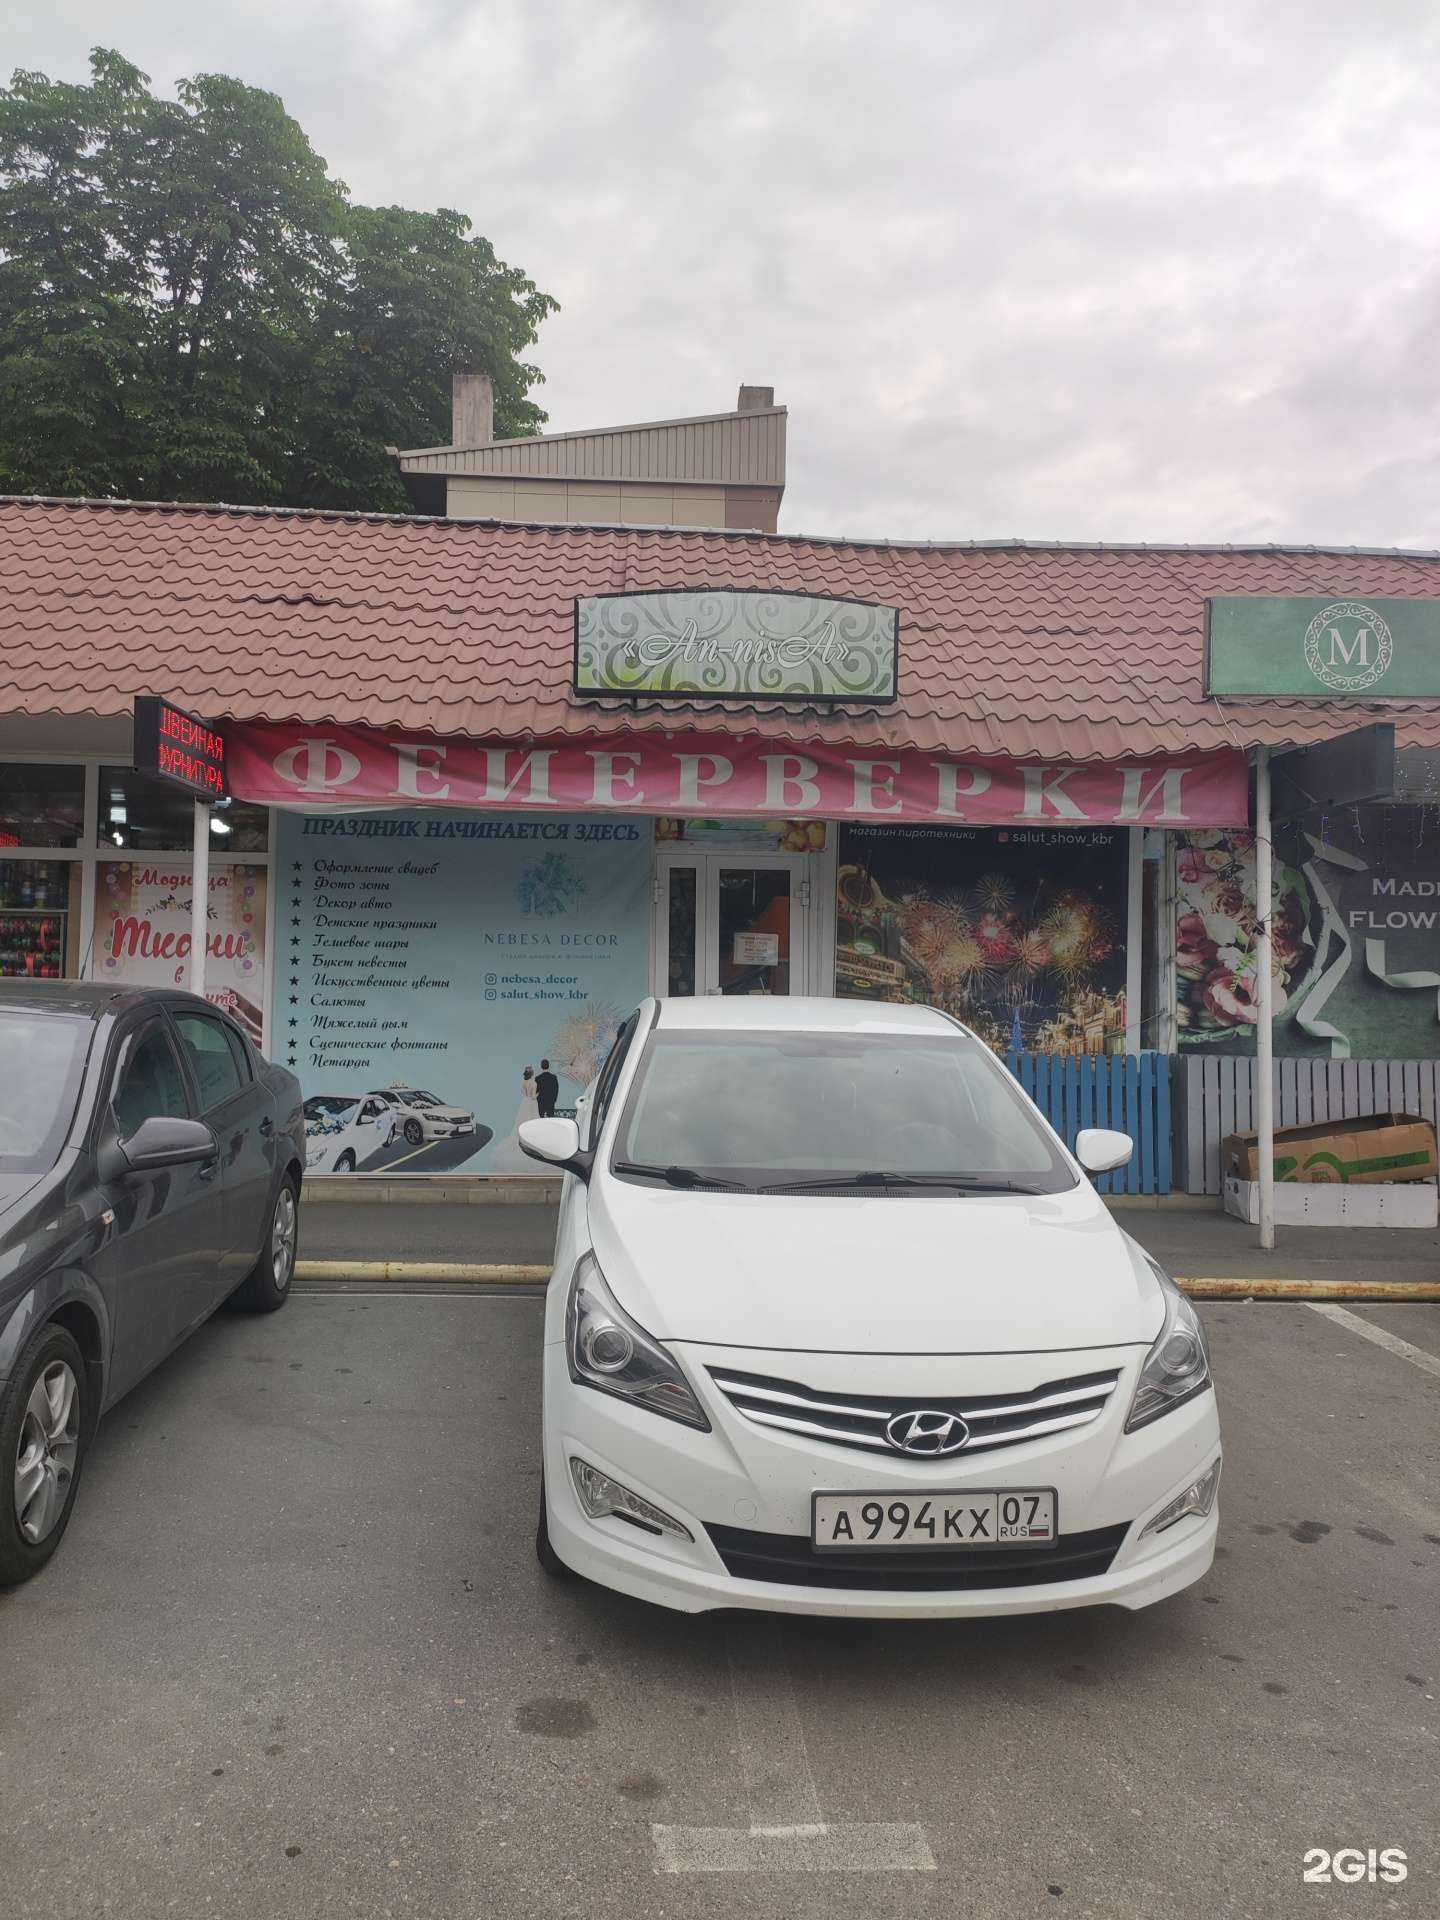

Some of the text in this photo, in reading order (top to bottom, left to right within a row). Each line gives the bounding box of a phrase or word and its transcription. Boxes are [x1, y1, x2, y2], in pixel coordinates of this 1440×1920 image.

[1327, 628, 1371, 666] M
[302, 817, 640, 842] ПРАЗДНИК НАЧИНАЕТСЯ ЗДЕСЬ
[1012, 832, 1114, 846] salut_show_kbr
[313, 859, 440, 876] Оформление свадеб
[135, 869, 230, 891] Моднца
[312, 876, 391, 891] Фото зоны
[1372, 878, 1440, 896] MAD
[312, 895, 392, 910] Декор авто
[312, 913, 438, 930] Детские праздники
[1349, 910, 1440, 929] FLOW
[312, 933, 409, 949] Гелиевые шары
[484, 933, 619, 946] NEBESA DECOR
[312, 953, 407, 969] Букет невесты
[311, 973, 450, 989] Искусственные цветы
[500, 974, 578, 985] nebesa_decor
[310, 993, 366, 1007] Салюты
[500, 988, 589, 1001] salut_show_kbr
[310, 1014, 408, 1030] Тяжелый дым
[309, 1035, 449, 1051] Сценические фонтаны
[308, 1053, 371, 1068] Петарды
[1002, 1496, 1041, 1526] 07
[1000, 1526, 1028, 1538] RUS
